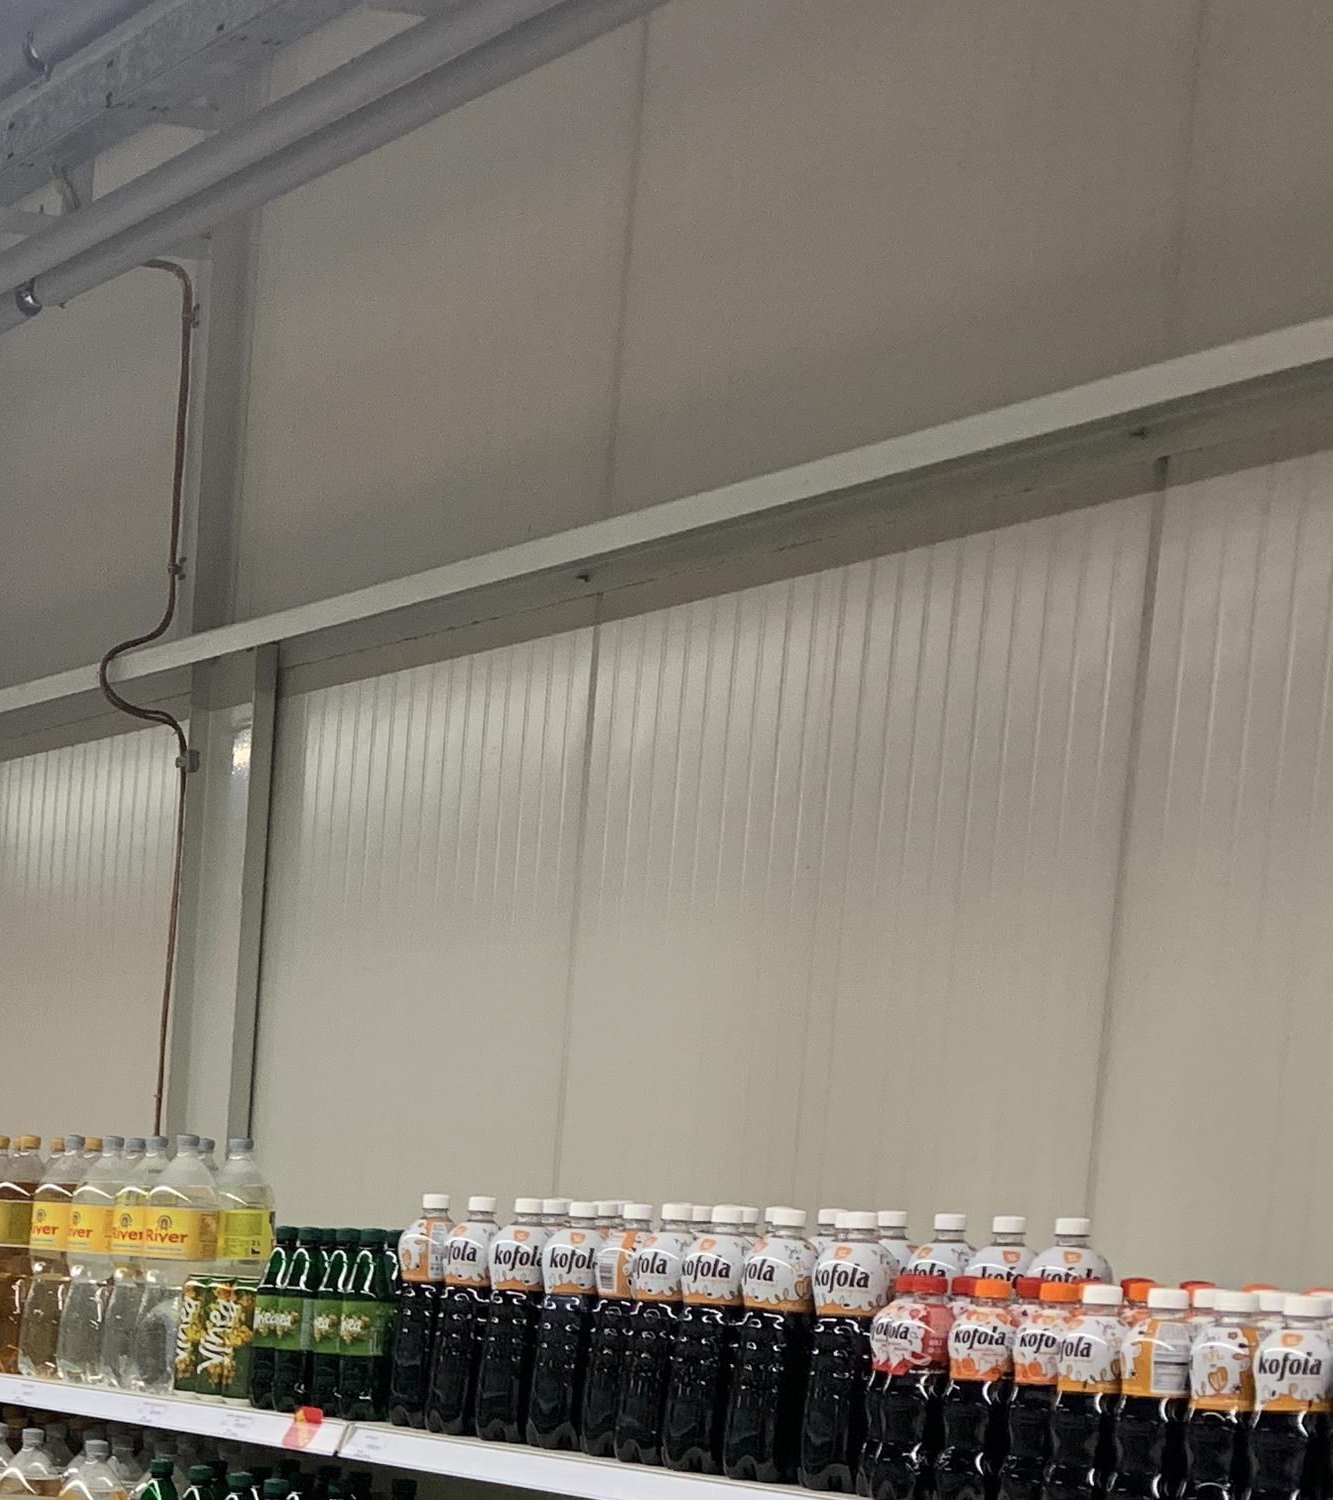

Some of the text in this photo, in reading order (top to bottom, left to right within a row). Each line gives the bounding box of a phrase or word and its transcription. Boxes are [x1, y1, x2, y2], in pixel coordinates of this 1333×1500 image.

[144, 1228, 189, 1245] River
[814, 1260, 870, 1295] kofola
[954, 1324, 1006, 1352] kofola
[1257, 1349, 1322, 1382] kofola
